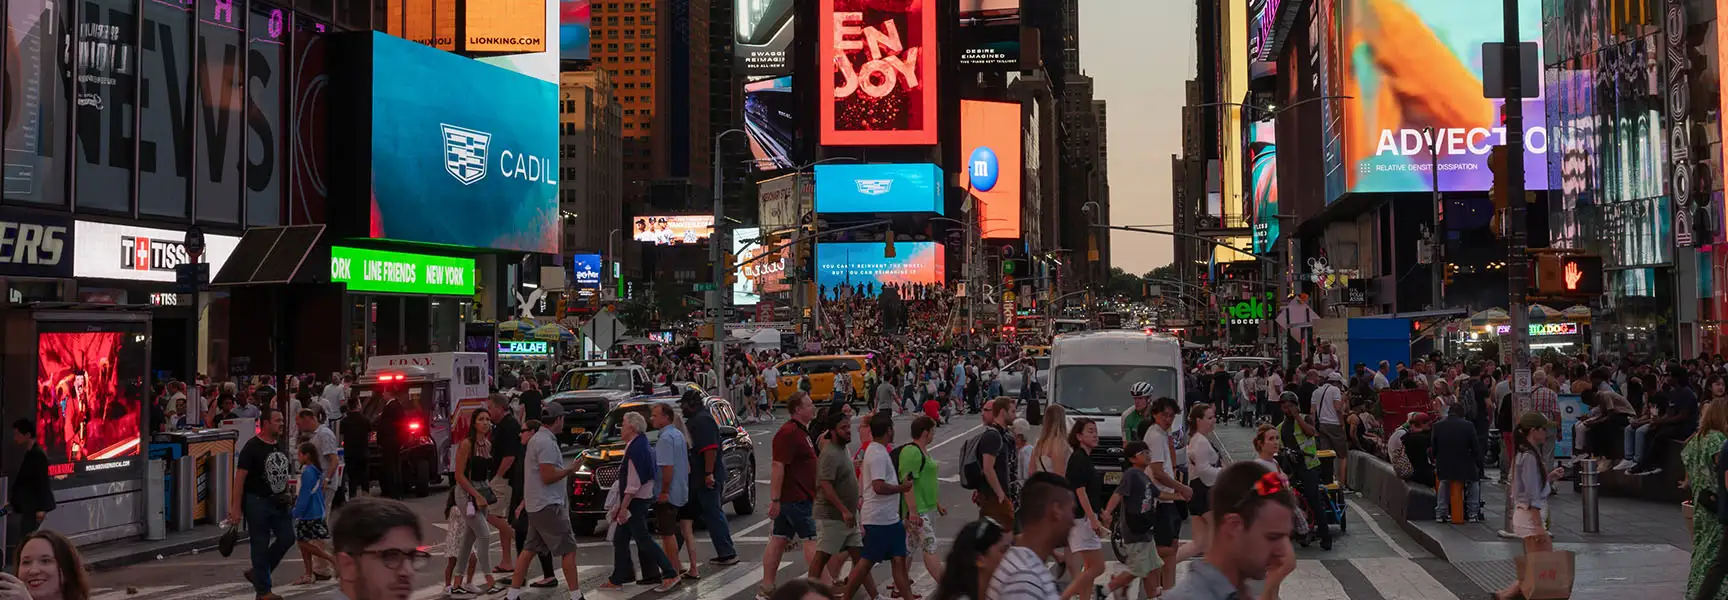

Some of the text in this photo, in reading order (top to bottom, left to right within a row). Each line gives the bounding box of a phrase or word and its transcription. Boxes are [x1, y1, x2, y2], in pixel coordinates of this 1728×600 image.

[470, 37, 540, 46] LIONKING.COM
[1666, 0, 1694, 248] POPEYE
[500, 149, 557, 185] CADIL
[1438, 163, 1478, 171] DISSIPATION
[363, 260, 382, 280] LINE
[383, 261, 416, 283] FRIENDS
[426, 265, 445, 284] NEW
[445, 266, 464, 285] YORK
